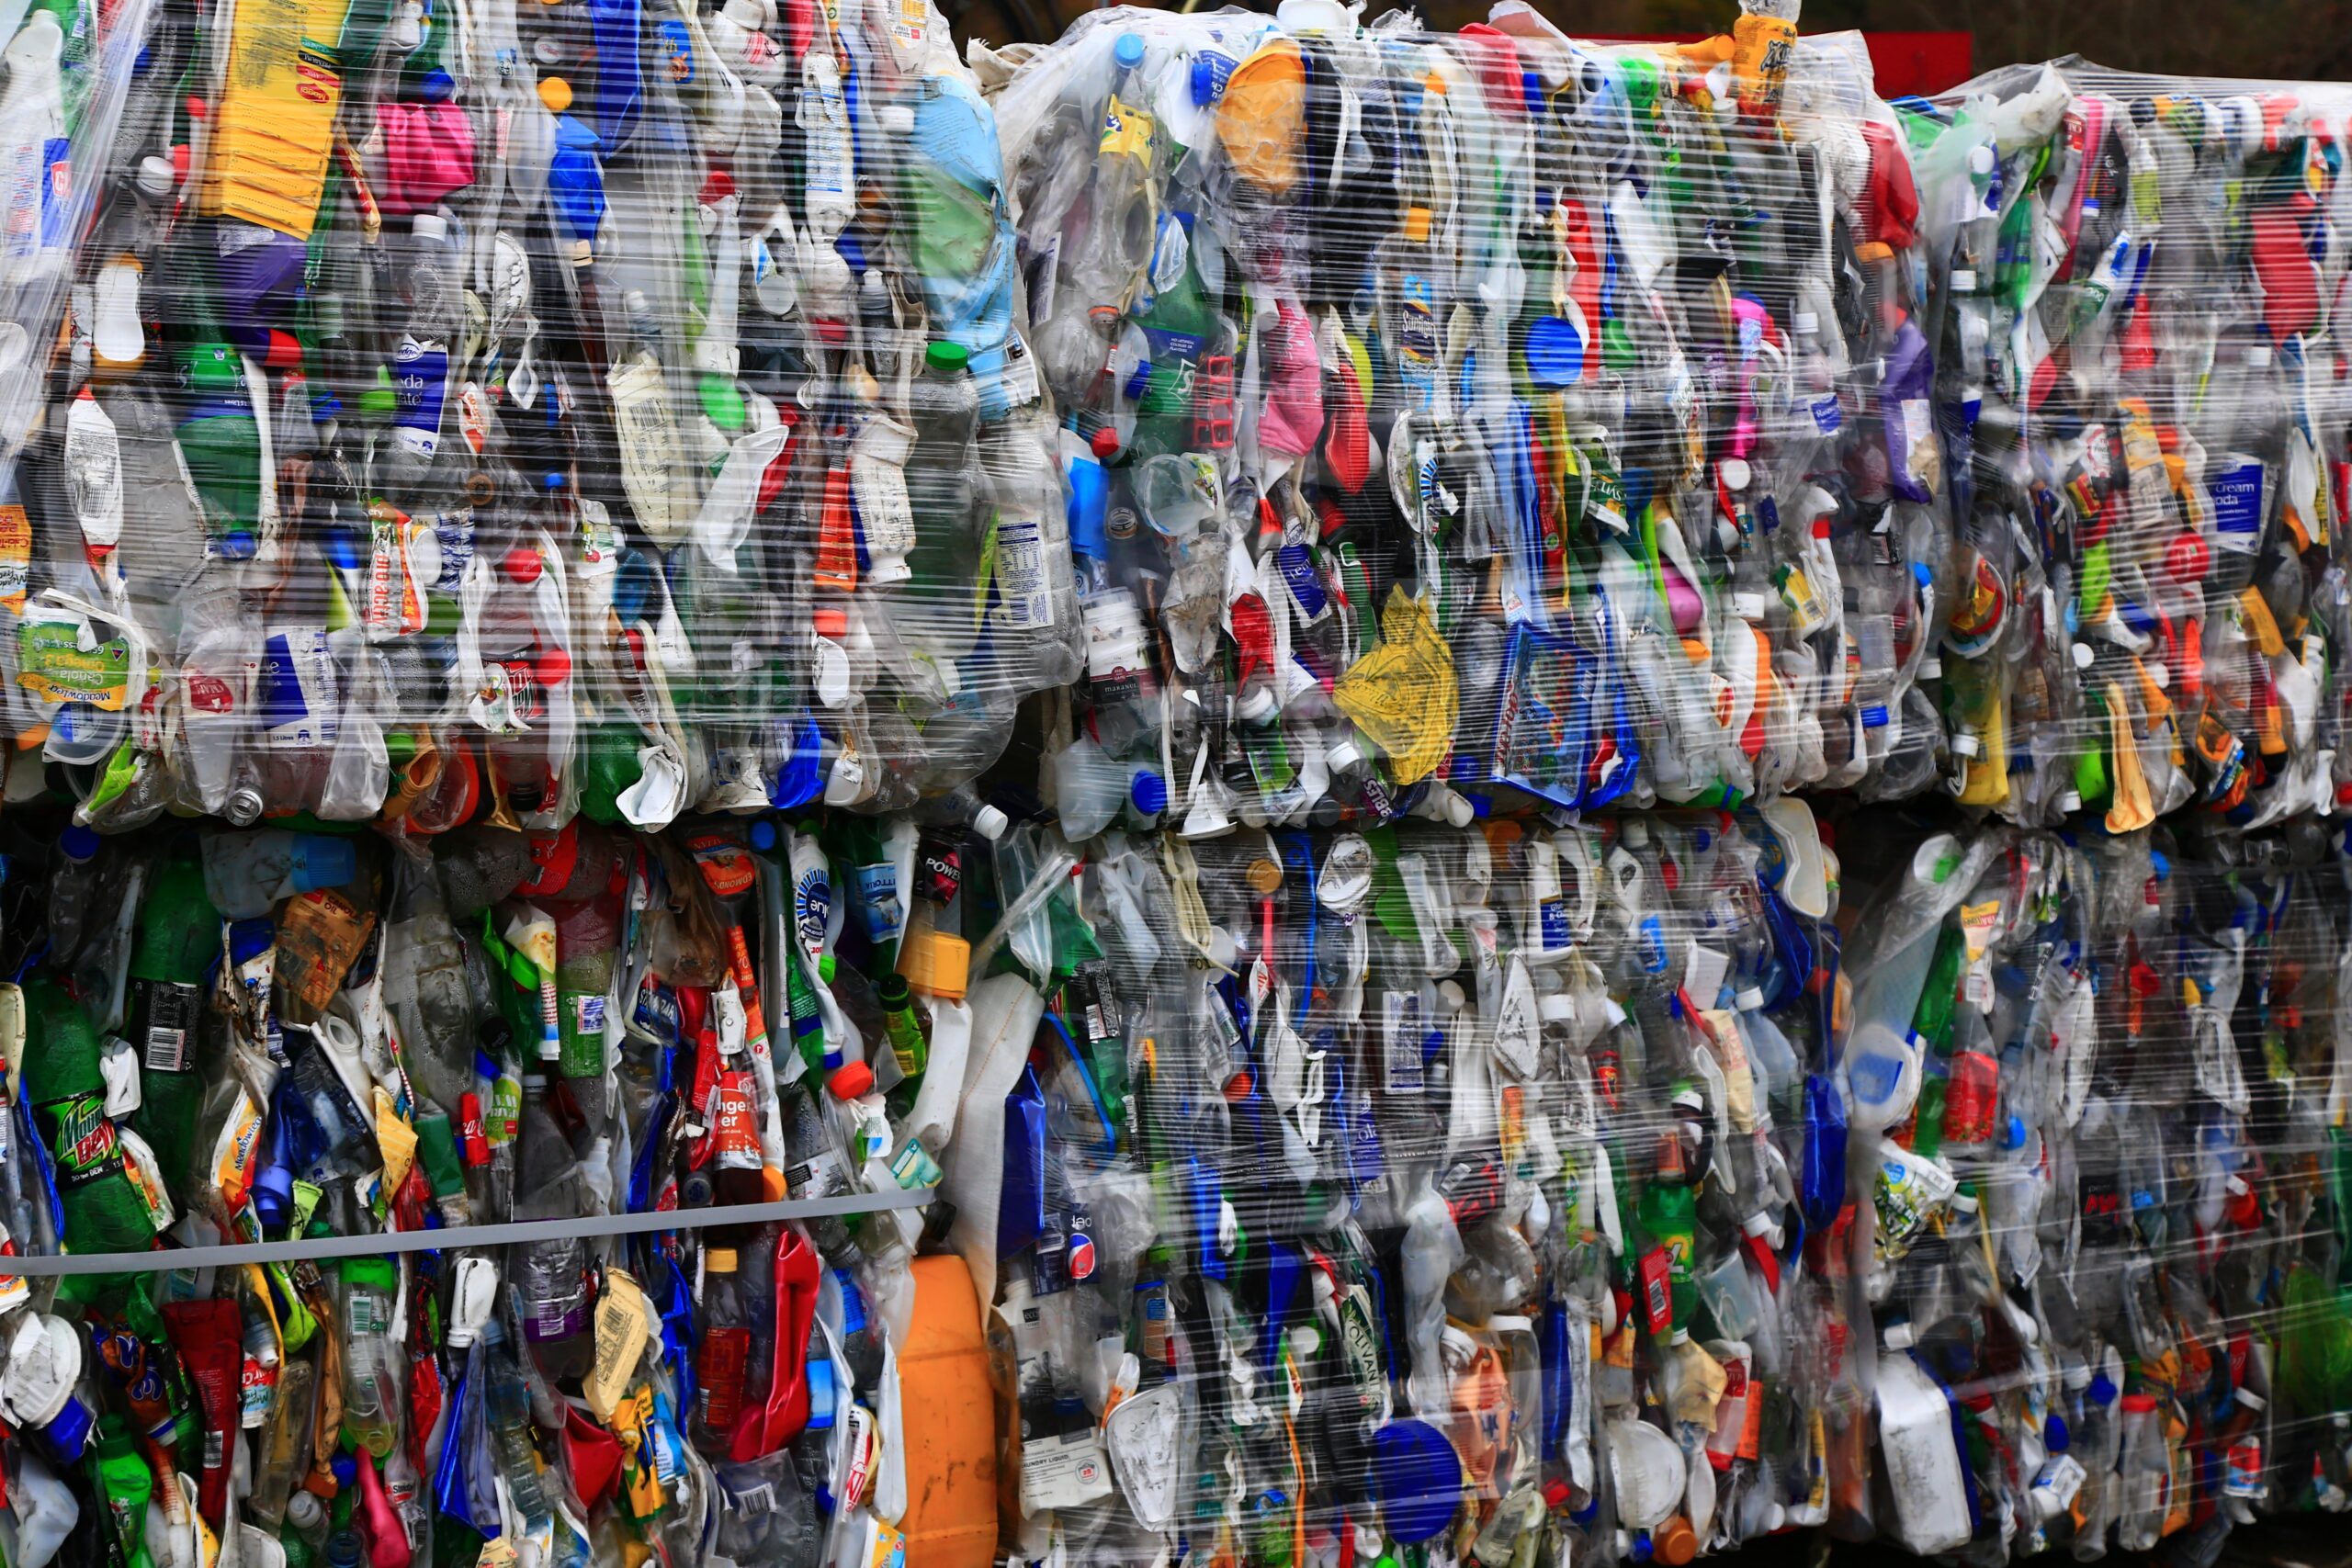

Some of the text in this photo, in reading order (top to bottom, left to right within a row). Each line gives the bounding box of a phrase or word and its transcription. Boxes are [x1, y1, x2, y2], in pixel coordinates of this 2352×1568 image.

[300, 85, 326, 102] Maggi
[2215, 482, 2256, 494] Cream
[45, 653, 106, 671] Omega 3
[58, 669, 104, 686] Canola
[49, 683, 111, 704] MeadowLea
[714, 872, 752, 890] EDMONDS
[865, 877, 896, 890] ITTORIA
[324, 901, 338, 916] OIL
[328, 895, 357, 919] CANOL
[809, 899, 830, 919] lue
[803, 925, 824, 937] goodness
[90, 1167, 104, 1179] DEW
[1049, 1453, 1069, 1464] LIQUID
